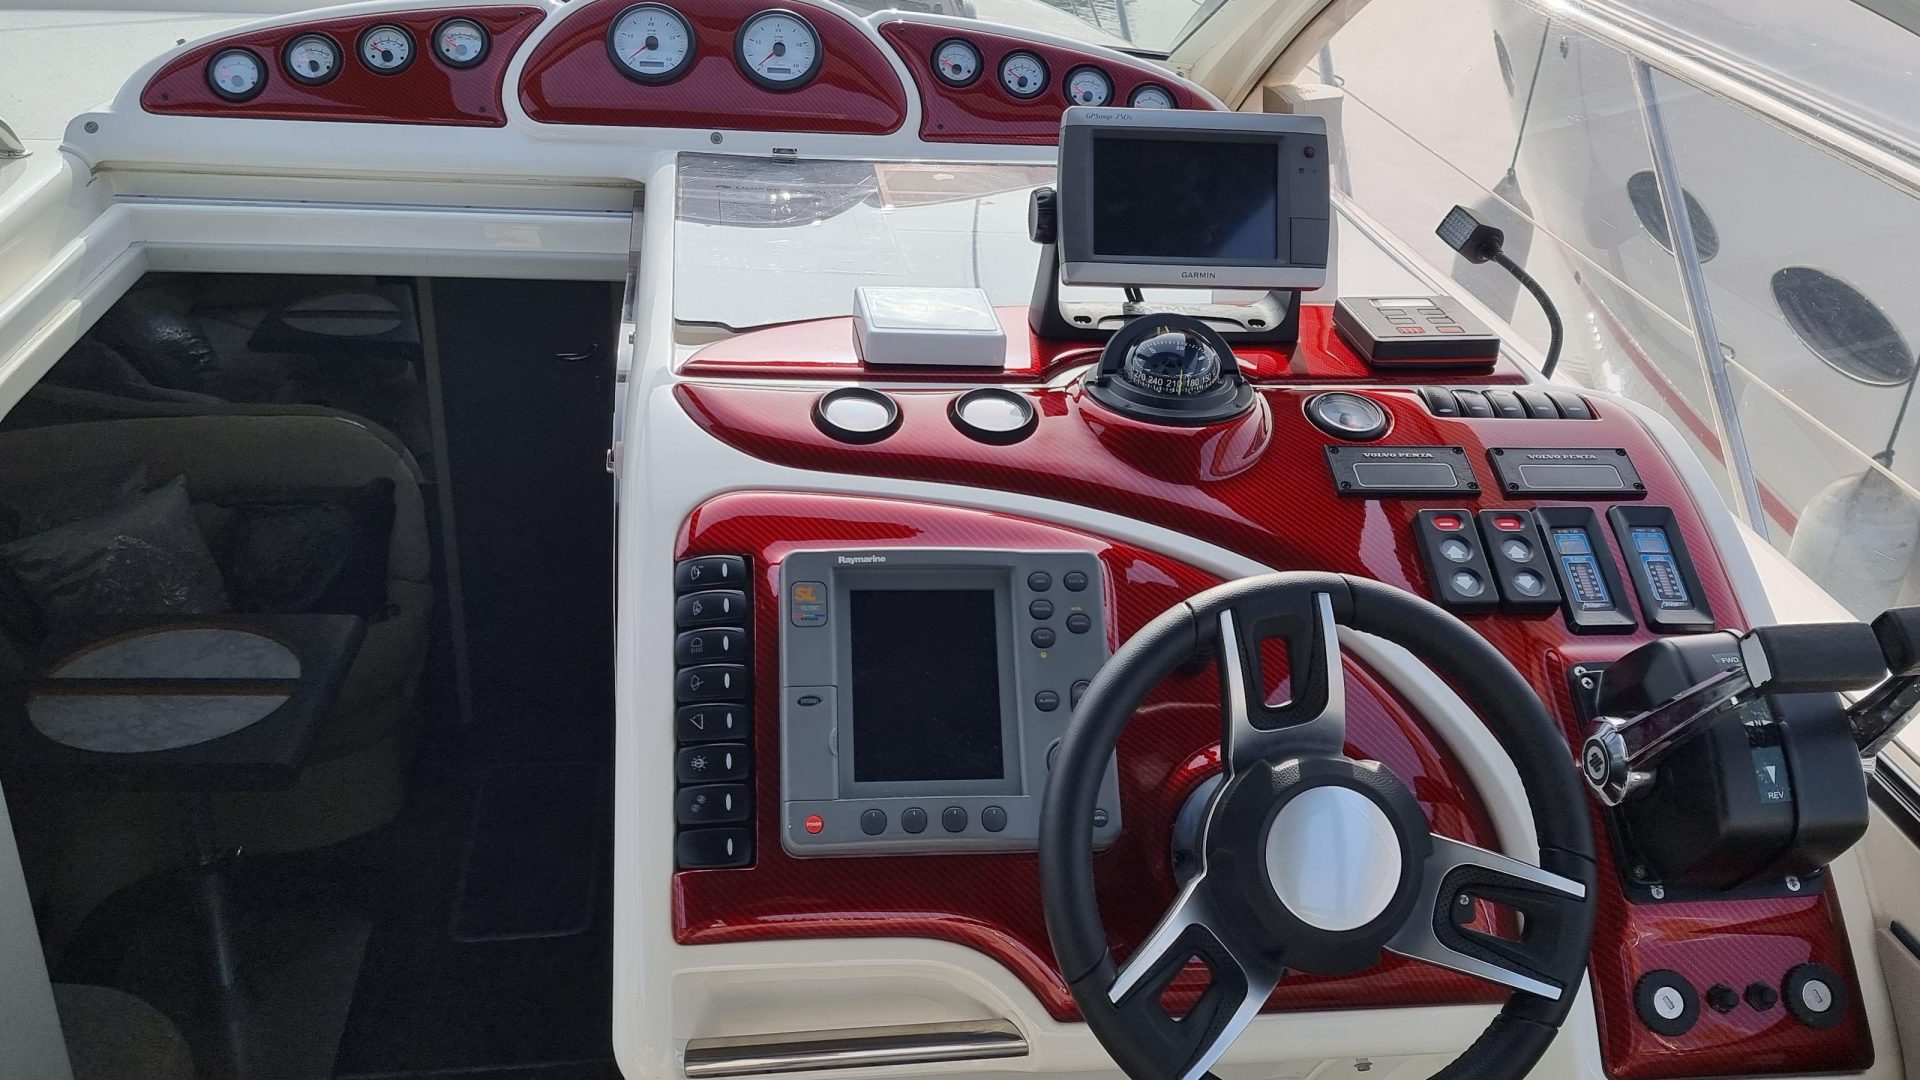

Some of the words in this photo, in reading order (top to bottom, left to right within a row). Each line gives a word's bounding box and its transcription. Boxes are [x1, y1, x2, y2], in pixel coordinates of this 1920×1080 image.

[1181, 271, 1216, 279] GARMIN
[1134, 370, 1146, 381] 270
[1147, 375, 1163, 386] 240
[1166, 378, 1182, 388] 210
[1186, 376, 1200, 387] 180
[838, 555, 886, 565] Raymarine
[1720, 656, 1740, 664] FWD
[1754, 719, 1762, 727] N
[1767, 791, 1785, 800] REV
